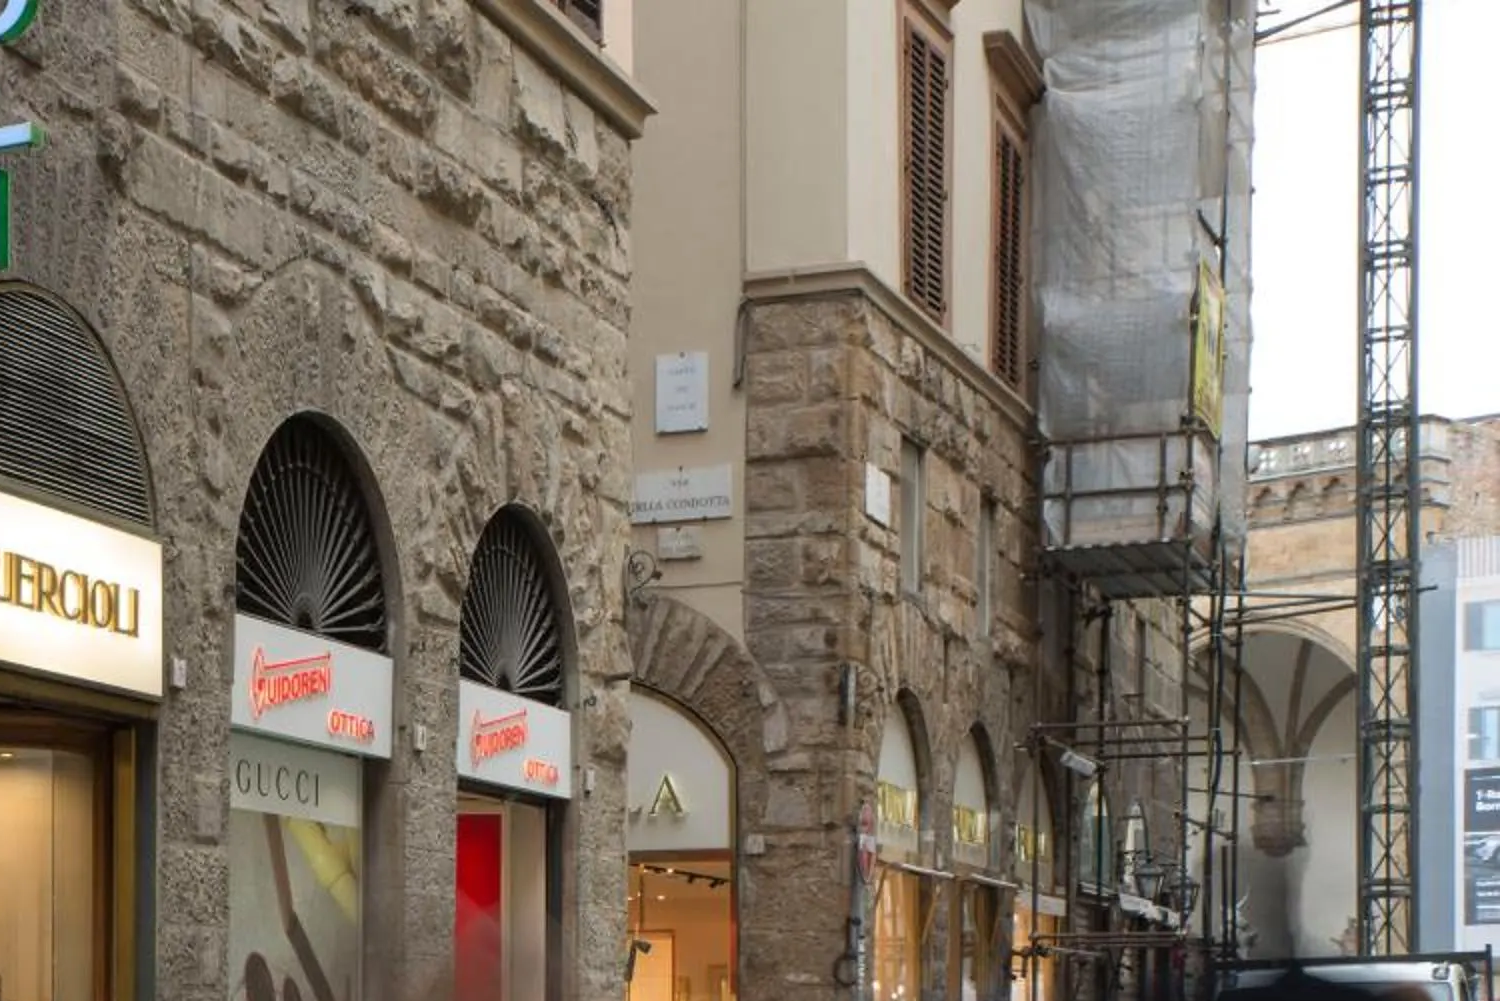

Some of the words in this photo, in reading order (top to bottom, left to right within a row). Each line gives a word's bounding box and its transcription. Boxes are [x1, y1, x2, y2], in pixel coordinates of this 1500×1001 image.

[665, 495, 730, 511] CONDOTTA
[329, 709, 374, 738] OTTICA
[236, 758, 319, 808] GUCCI
